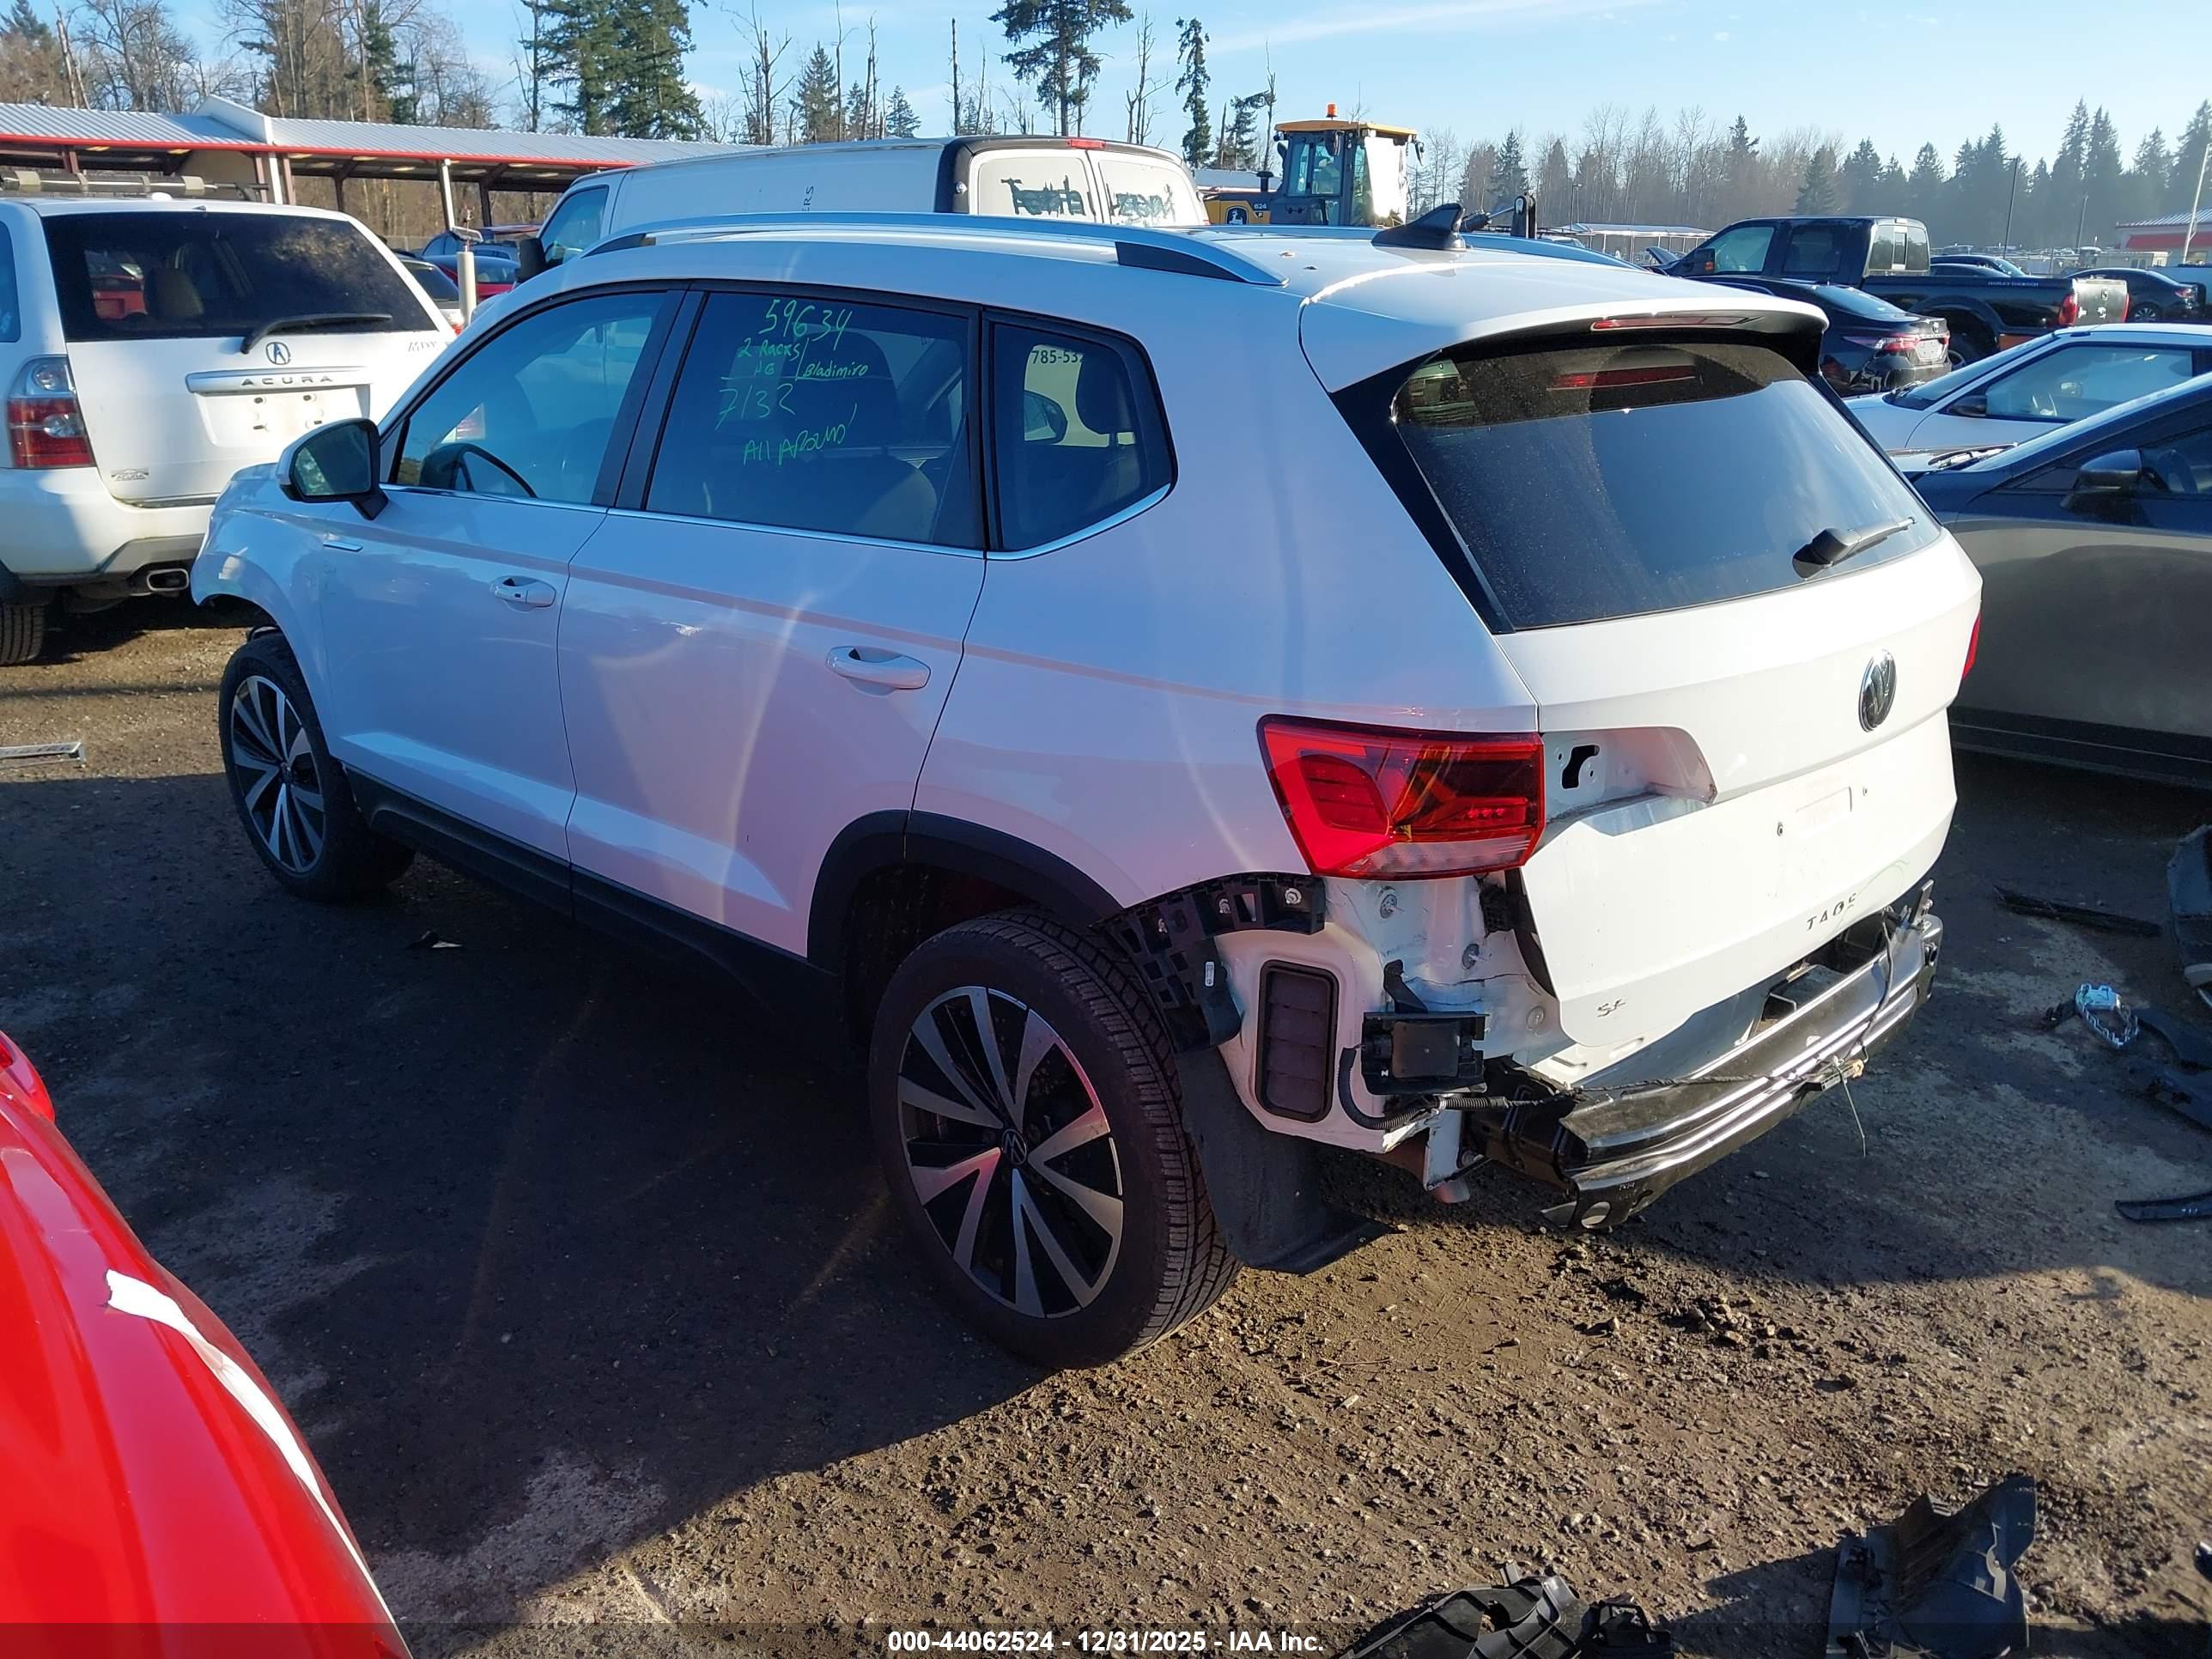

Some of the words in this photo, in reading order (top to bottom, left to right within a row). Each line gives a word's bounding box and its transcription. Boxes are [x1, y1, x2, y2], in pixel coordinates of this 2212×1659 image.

[759, 300, 853, 350] 59634
[1030, 349, 1084, 364] 785-53
[241, 376, 333, 386] ACURA
